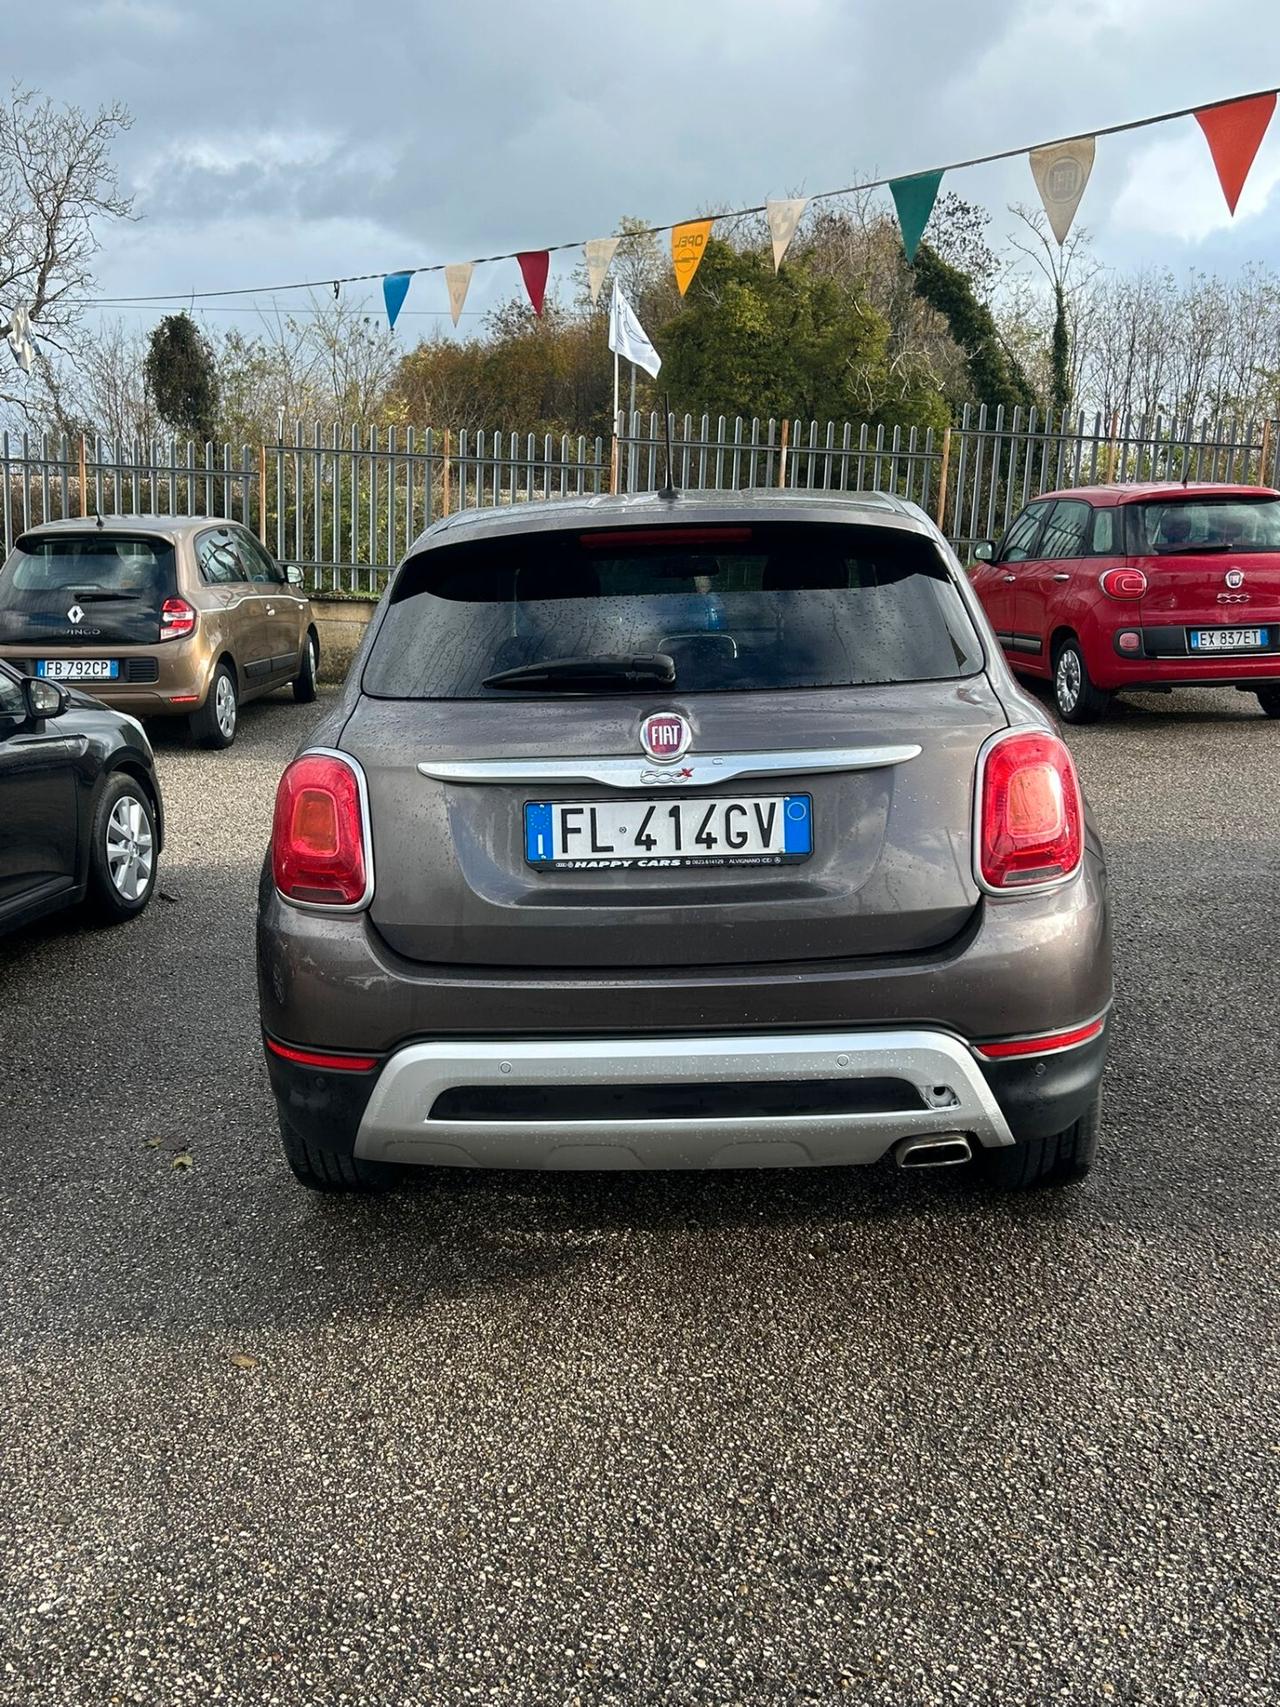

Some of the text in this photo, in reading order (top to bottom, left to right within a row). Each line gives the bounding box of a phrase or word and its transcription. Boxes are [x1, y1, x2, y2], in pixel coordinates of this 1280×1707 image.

[1200, 632, 1215, 646] EX
[1220, 631, 1259, 645] 837ET
[46, 661, 109, 675] FB 792CP
[651, 725, 680, 746] FIAT
[560, 801, 777, 854] FL 414GV
[574, 860, 633, 868] HAPPY
[637, 859, 681, 867] CARS
